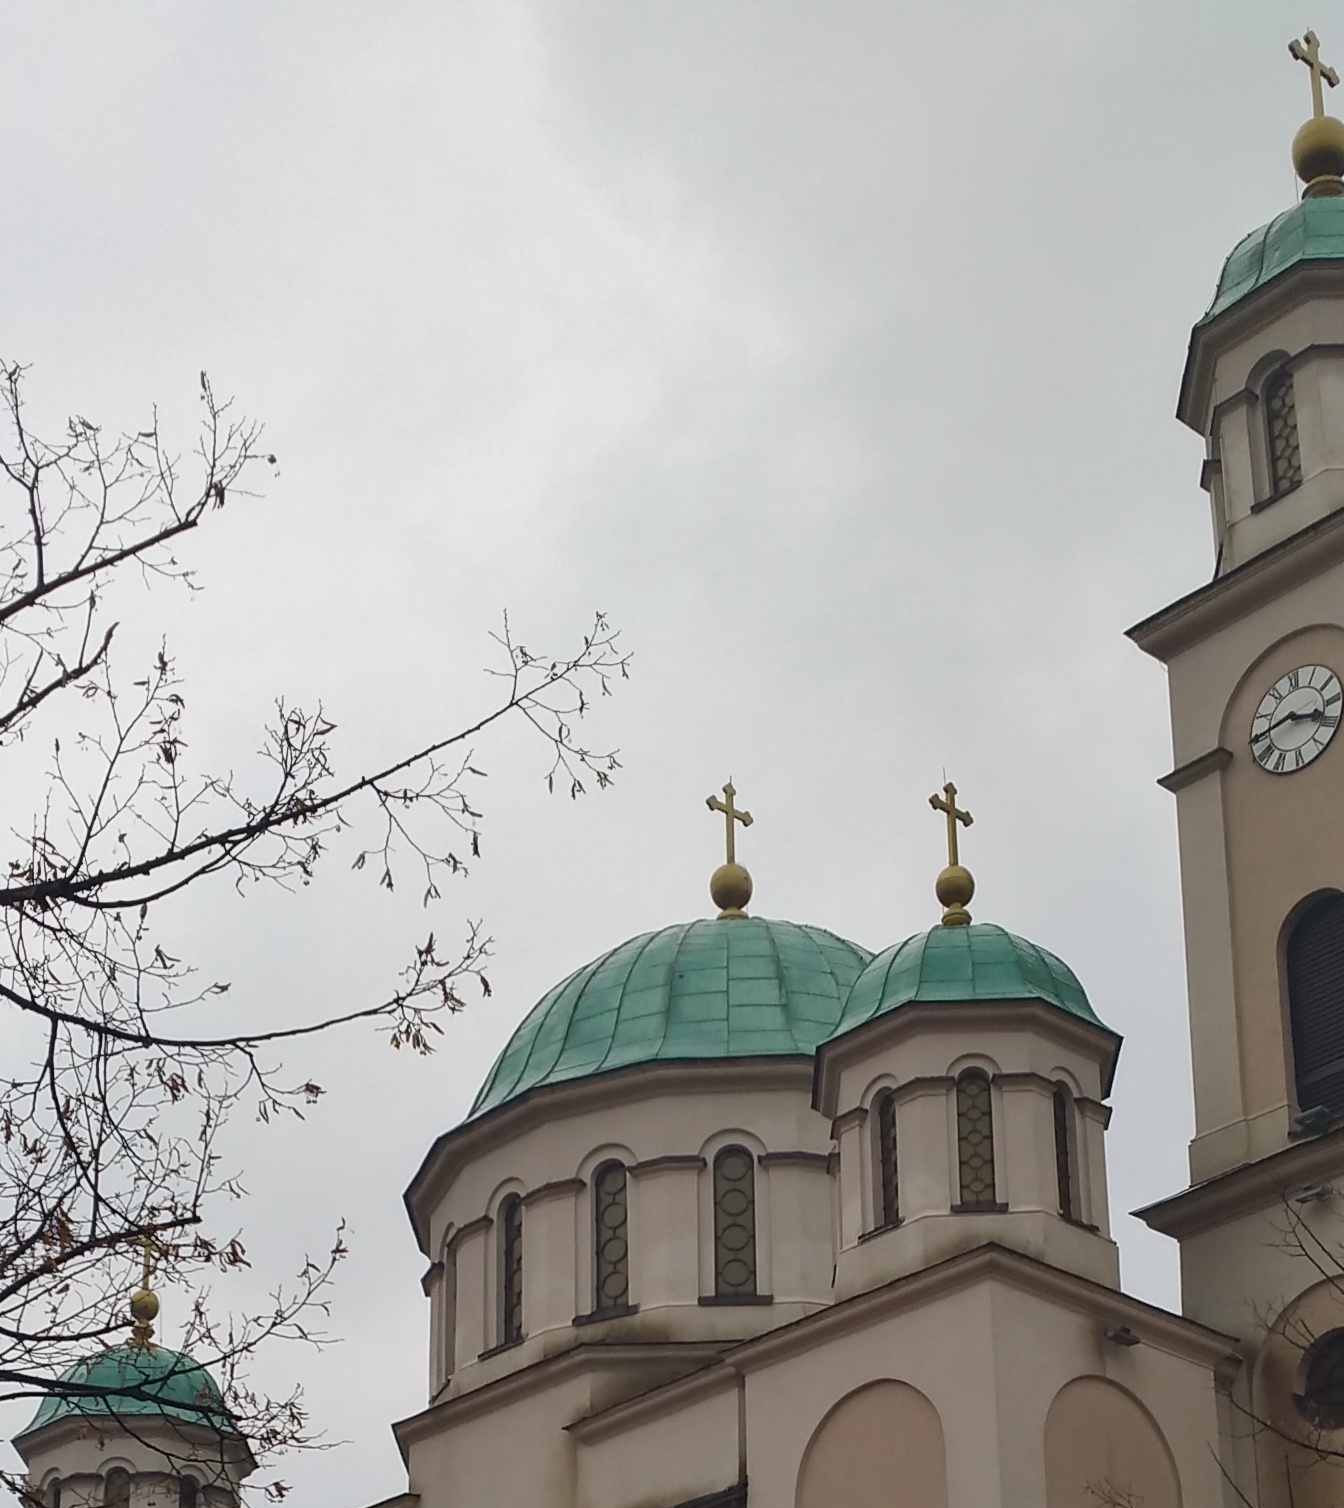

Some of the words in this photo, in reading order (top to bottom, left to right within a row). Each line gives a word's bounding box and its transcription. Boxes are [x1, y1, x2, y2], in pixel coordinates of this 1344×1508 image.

[1288, 670, 1299, 692] XII
[1308, 667, 1316, 685] I
[1269, 687, 1283, 704] XI
[1256, 712, 1271, 720] X
[1312, 737, 1324, 751] V
